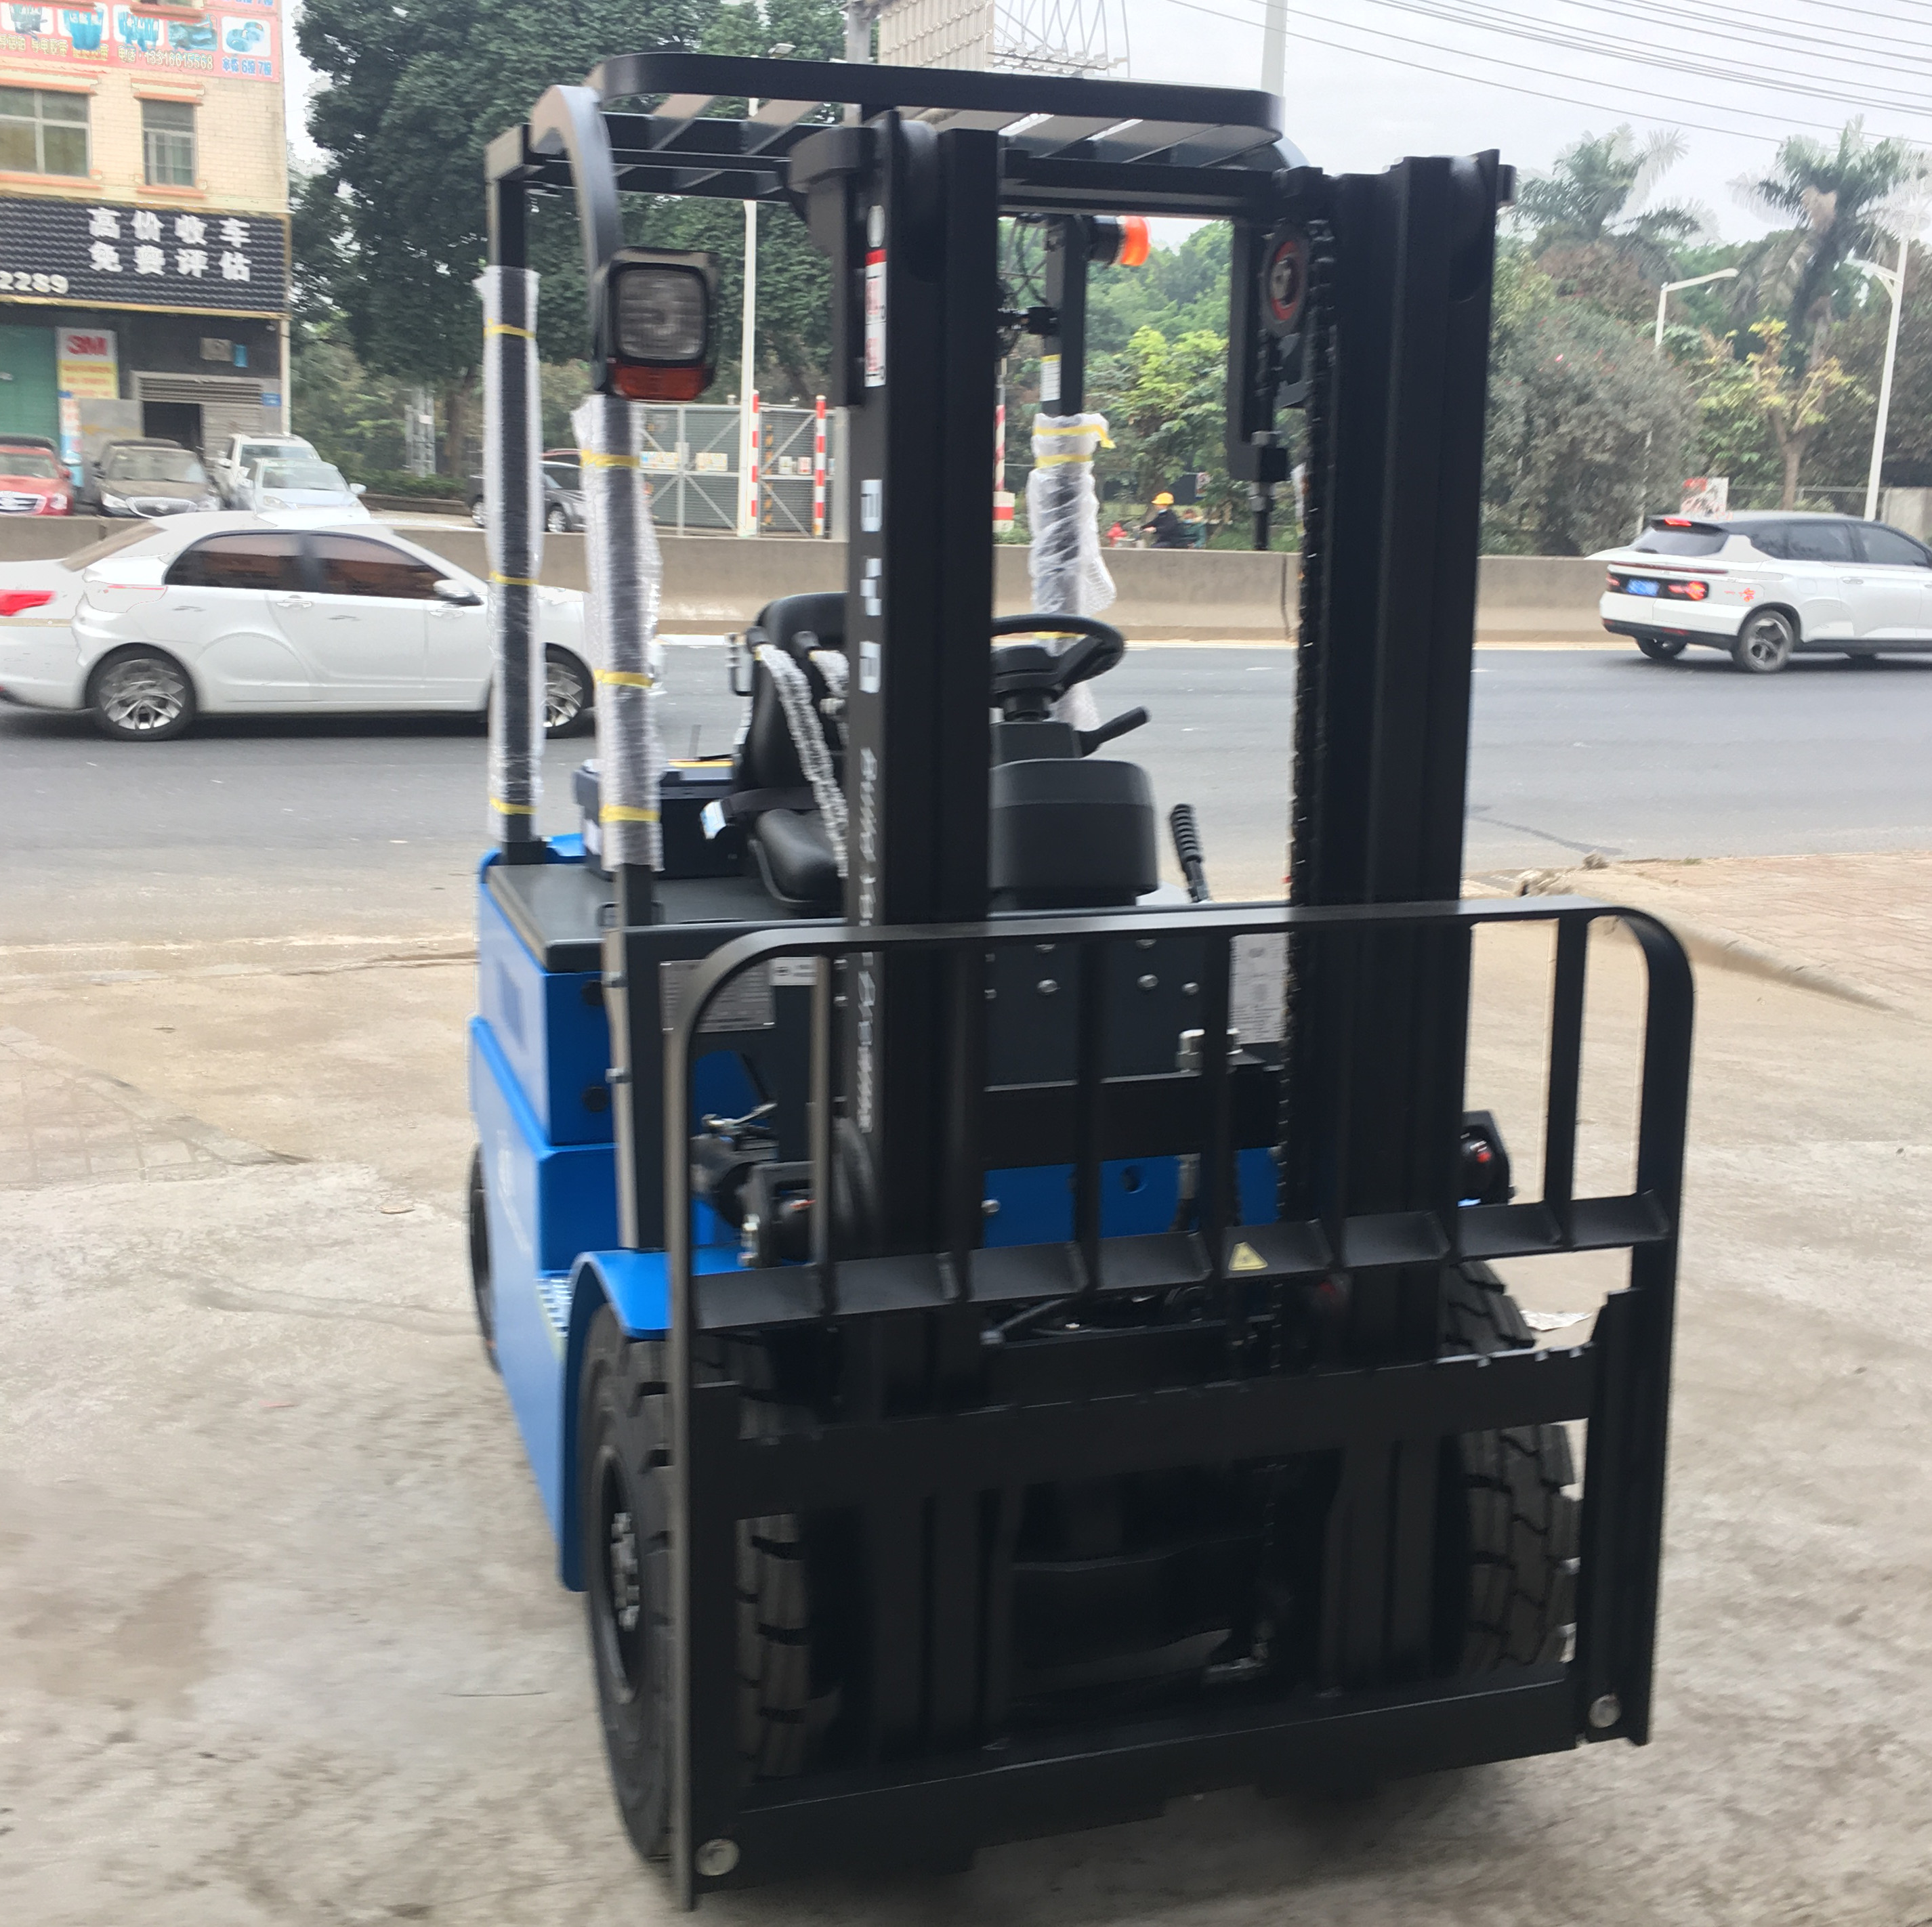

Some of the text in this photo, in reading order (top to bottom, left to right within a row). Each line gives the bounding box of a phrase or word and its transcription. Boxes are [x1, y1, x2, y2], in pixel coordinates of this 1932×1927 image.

[87, 207, 252, 248] 高价收车
[88, 240, 252, 282] 免费评估
[66, 335, 108, 356] 3M
